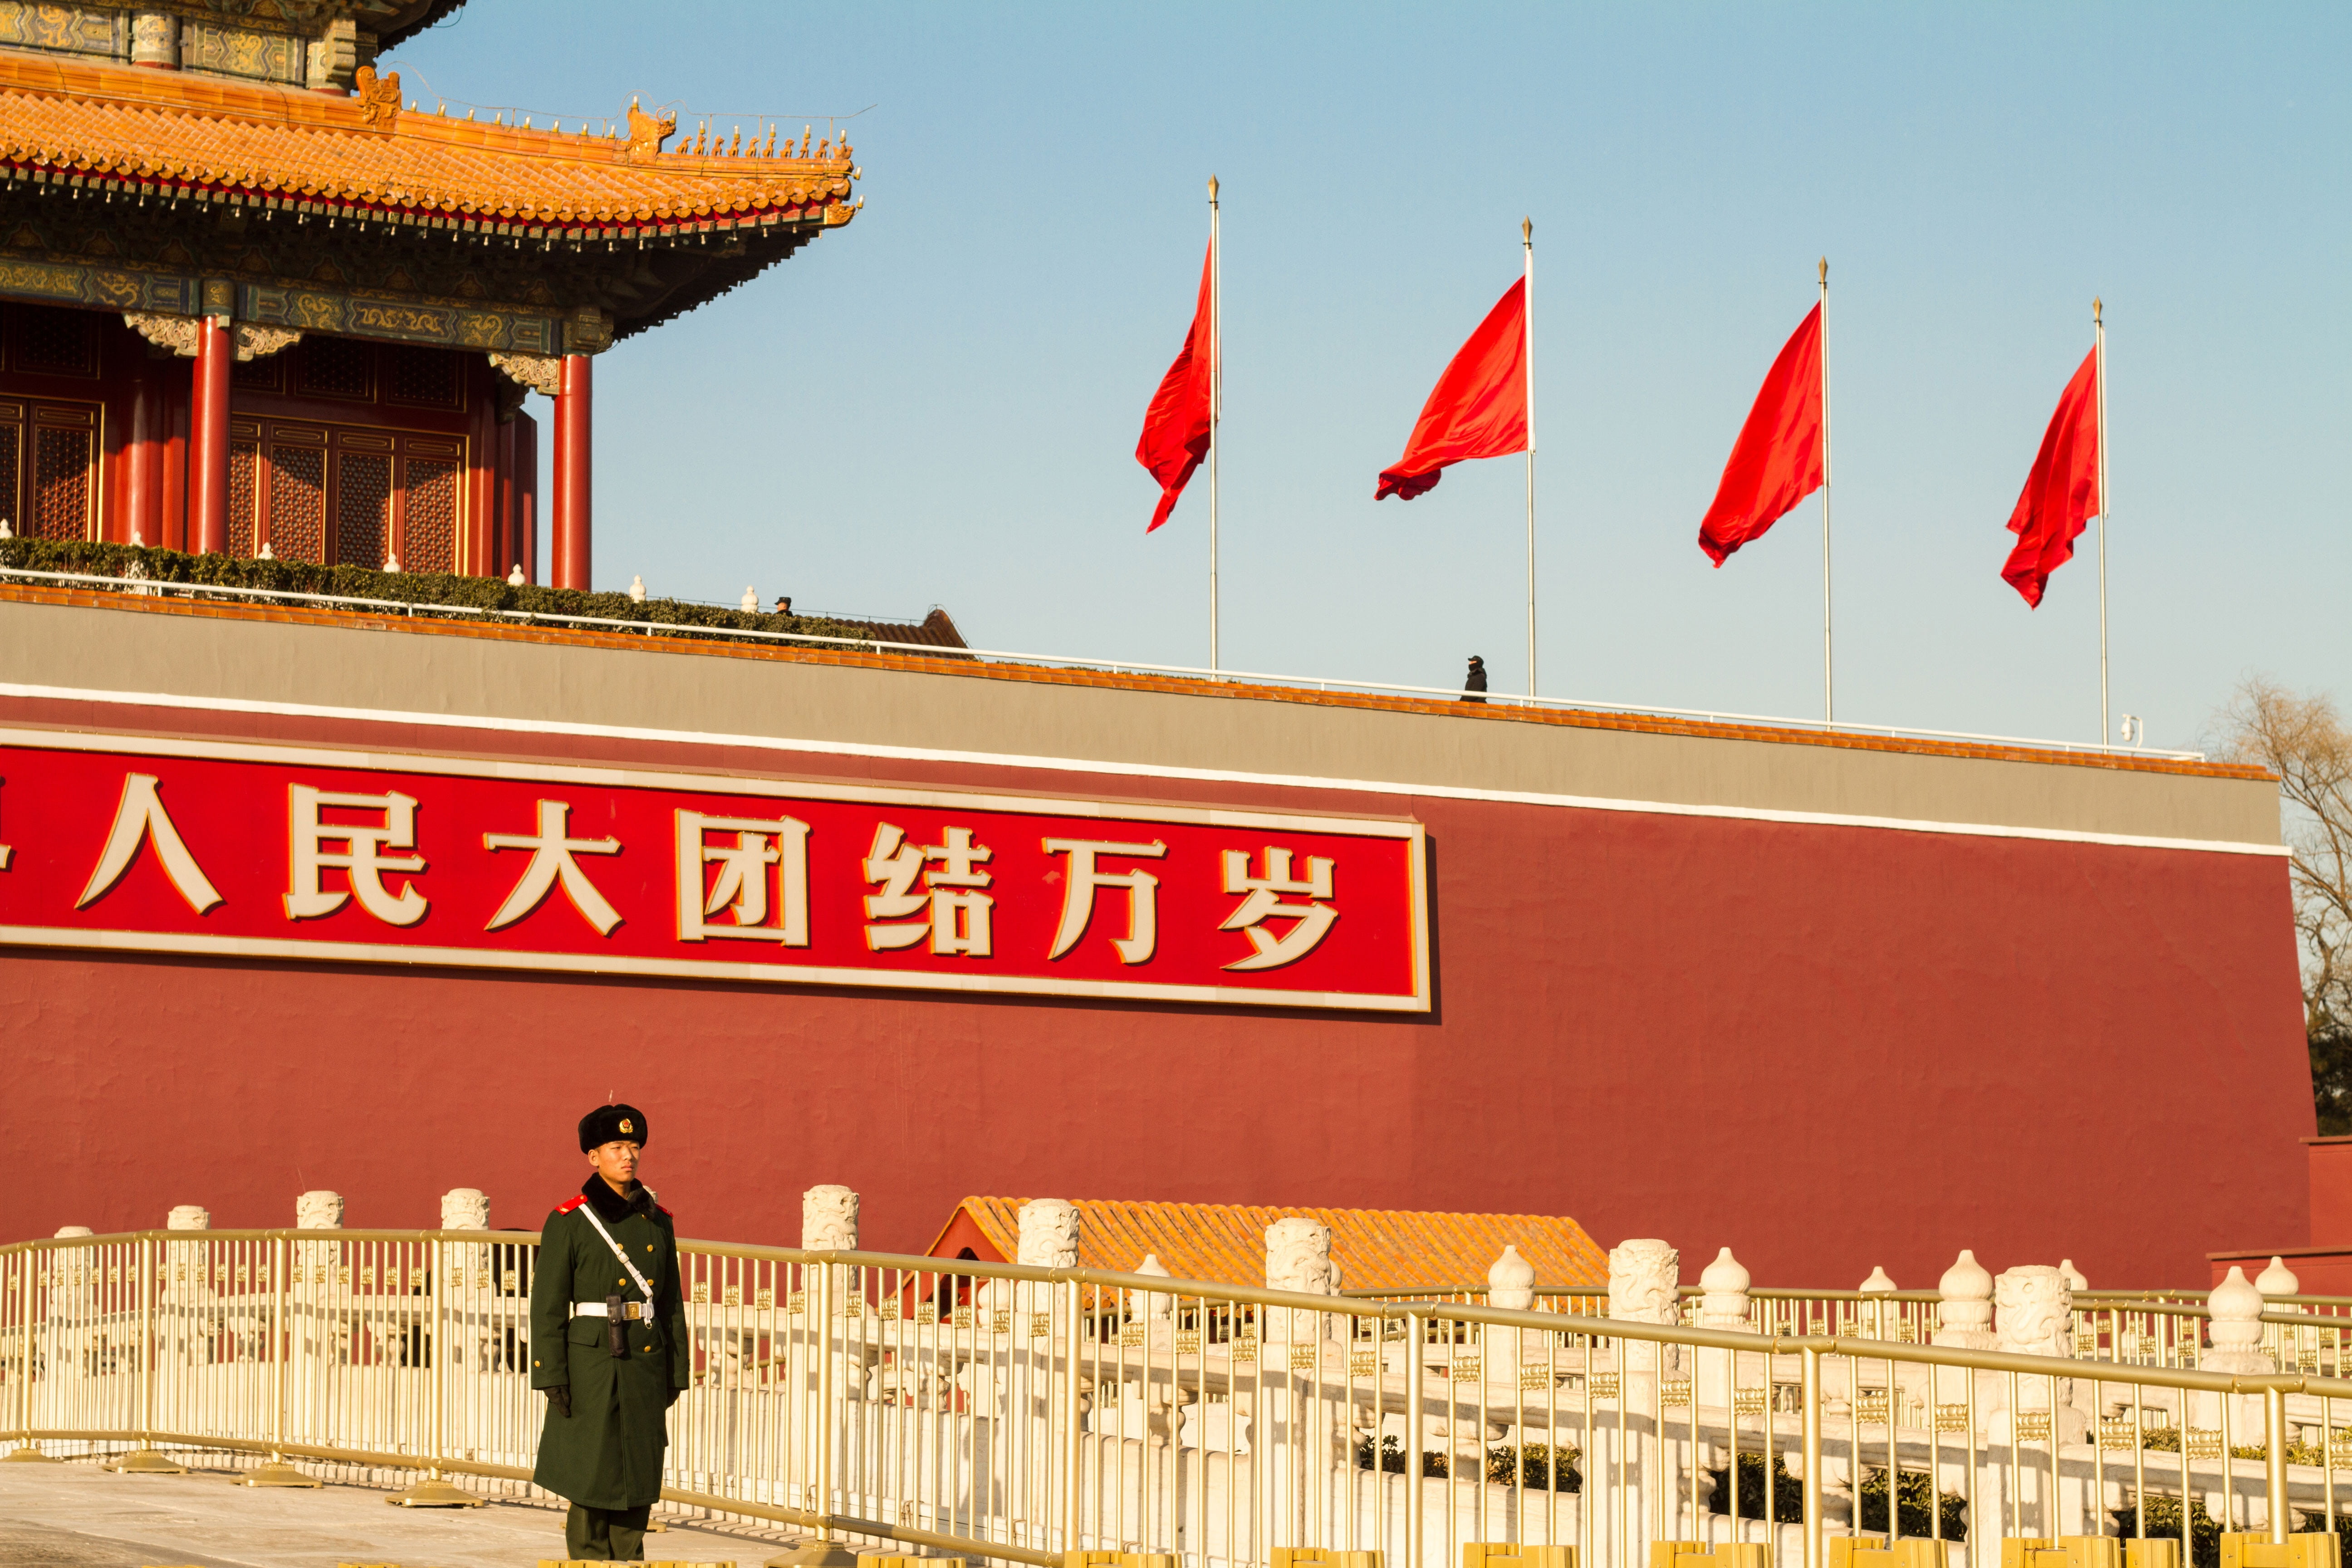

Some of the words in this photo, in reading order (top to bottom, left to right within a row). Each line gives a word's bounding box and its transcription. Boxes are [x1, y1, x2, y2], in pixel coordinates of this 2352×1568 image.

[0, 771, 1338, 970] 人民大团结万岁
